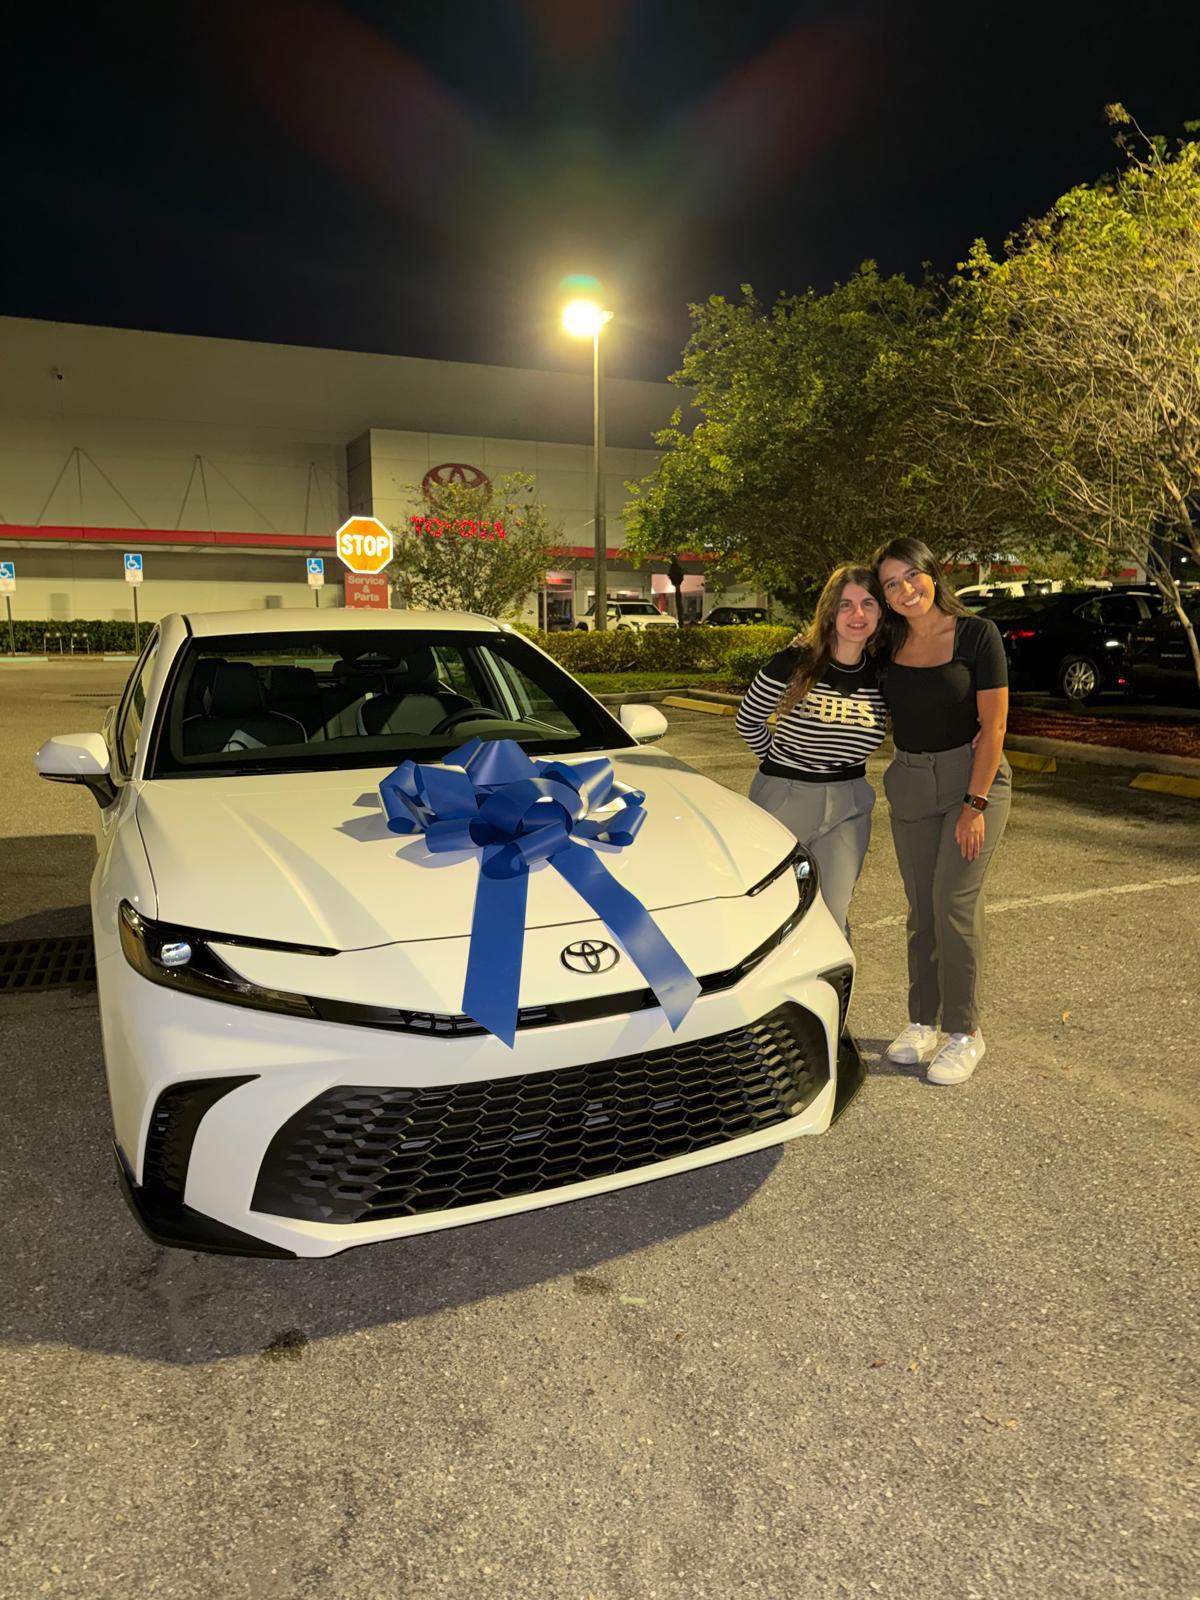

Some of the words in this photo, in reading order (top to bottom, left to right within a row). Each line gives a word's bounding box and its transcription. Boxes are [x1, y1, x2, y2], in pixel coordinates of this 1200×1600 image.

[341, 534, 389, 557] STOP
[348, 575, 385, 586] Service
[362, 585, 370, 594] &
[354, 592, 380, 602] Parts
